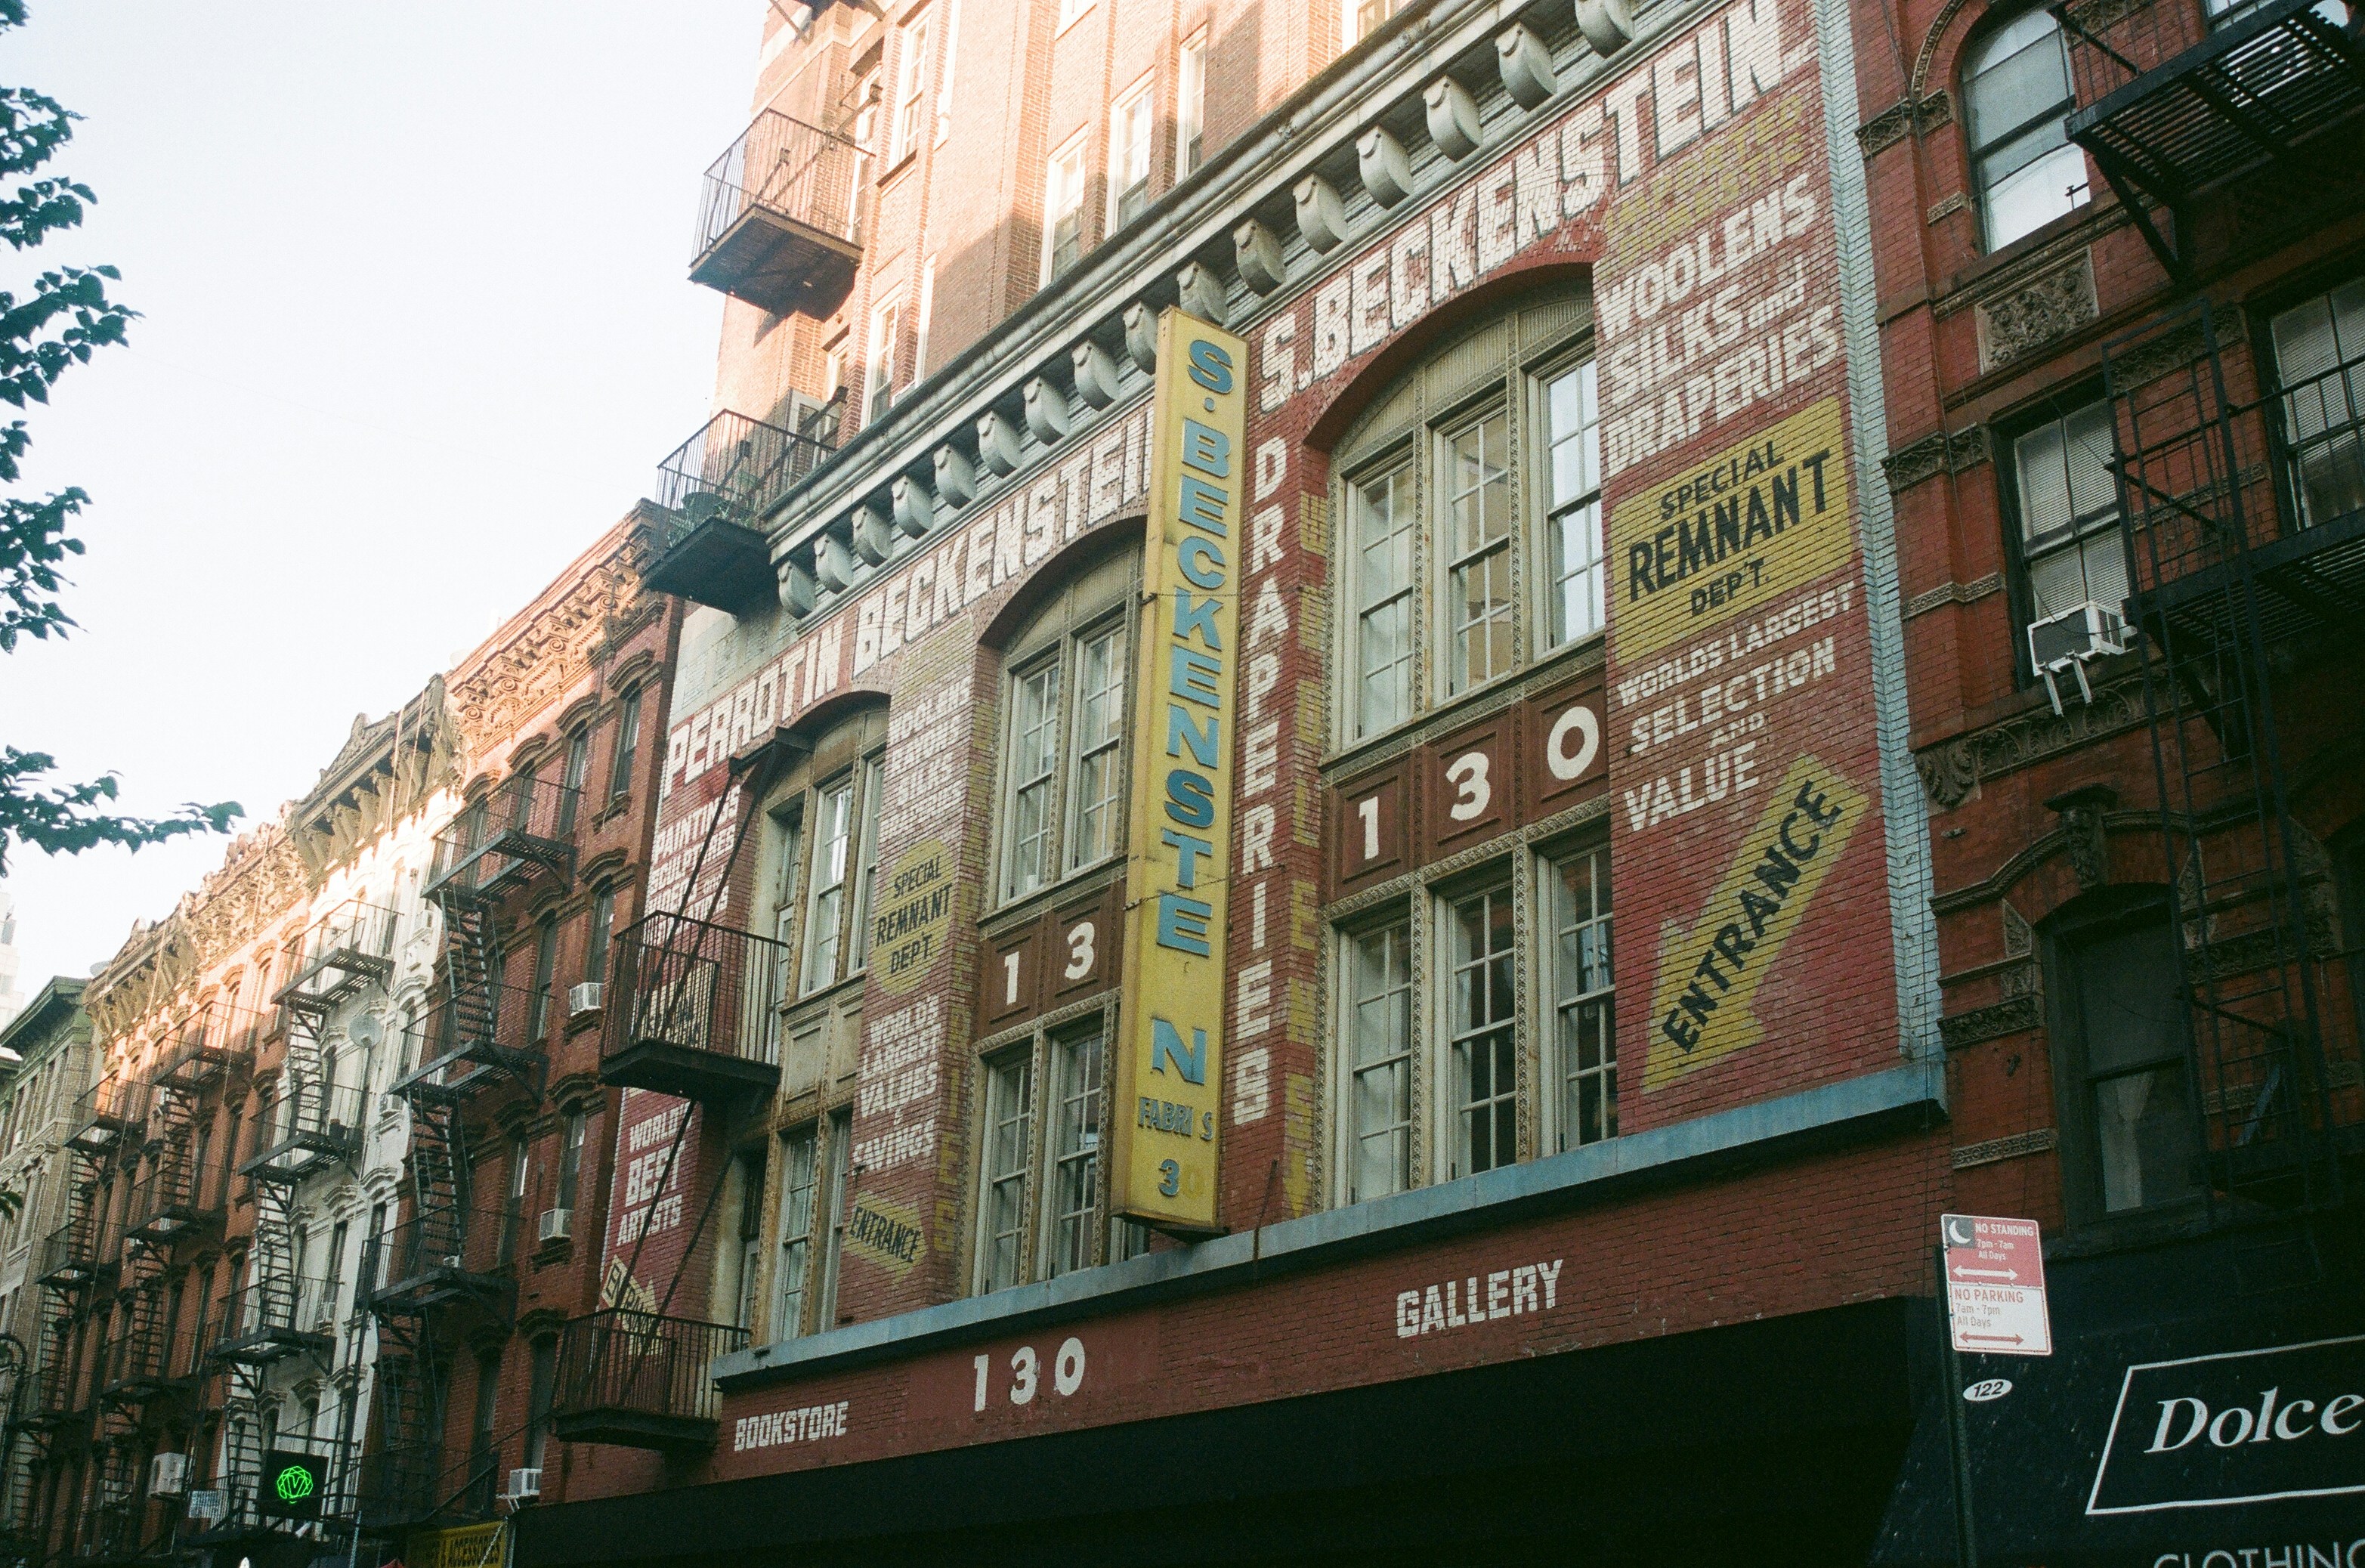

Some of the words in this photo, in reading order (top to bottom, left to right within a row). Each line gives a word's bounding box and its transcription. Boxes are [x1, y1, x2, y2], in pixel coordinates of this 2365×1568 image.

[1595, 172, 1818, 339] WOOLENS
[1609, 285, 1739, 406] SILKS
[1748, 255, 1809, 331] and
[1606, 304, 1838, 476] DRAPERIES
[1660, 440, 1785, 519] SPECIAL
[1629, 448, 1830, 603] REMNANT
[1731, 580, 1855, 660] LARGEST
[663, 616, 845, 801] PERROTIN
[889, 676, 971, 745] WOOLENS
[1631, 637, 1836, 756] SELECTION
[897, 752, 953, 806] SILKS
[1151, 417, 1232, 1086] BECKENSTEN
[1232, 435, 1288, 1126] DRAPERIES
[1624, 740, 1760, 833] VALUE
[648, 824, 736, 896] SCULPTRES
[894, 855, 941, 899] SPECIAL
[876, 883, 953, 947] REMNANT
[1662, 779, 1844, 1053] ENTRANCE
[862, 1022, 941, 1081] LARGEST
[861, 1060, 938, 1118] VALUES
[625, 1140, 686, 1208] BEST
[616, 1194, 682, 1247] ARTSTS
[849, 1205, 920, 1263] ENTRANCE
[1974, 1223, 1989, 1234] NO
[1989, 1223, 2034, 1237] STANDING
[1978, 1251, 1988, 1260] All
[1989, 1251, 2007, 1261] Days
[1397, 1259, 1563, 1338] GALLERY
[1955, 1288, 1971, 1300] NO
[1974, 1289, 2024, 1304] PARKING
[1955, 1303, 1974, 1314] 7am
[1983, 1304, 2001, 1316] 7pm
[1957, 1316, 1969, 1327] All
[1971, 1316, 1992, 1329] Days
[973, 1337, 1086, 1412] 130
[1973, 1381, 2004, 1398] 122
[733, 1400, 849, 1452] BOOKSTORE
[2143, 1386, 2365, 1454] Dolce
